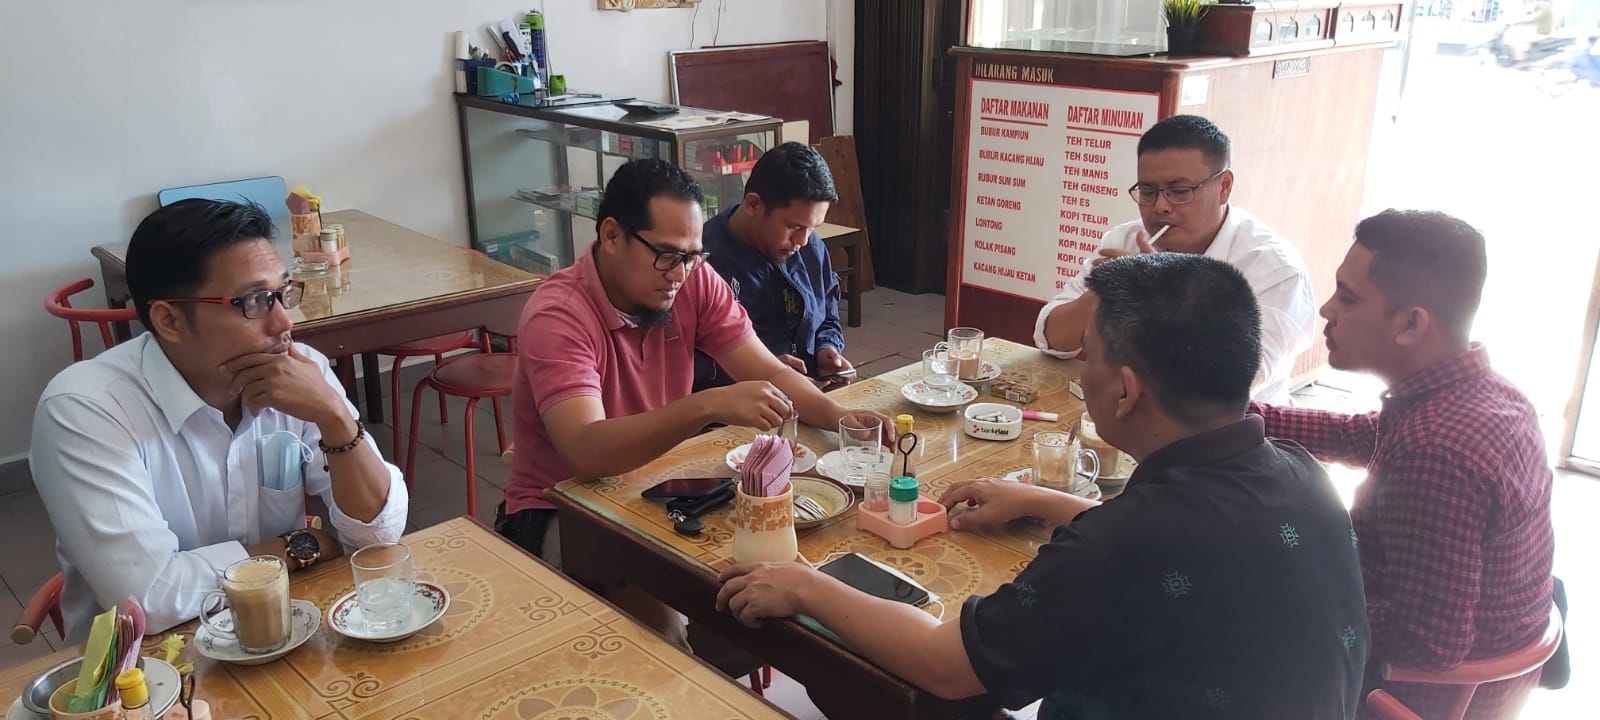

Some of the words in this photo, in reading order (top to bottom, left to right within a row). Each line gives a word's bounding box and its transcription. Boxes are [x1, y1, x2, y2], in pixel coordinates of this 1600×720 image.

[975, 63, 1017, 80] DILARANG
[1021, 66, 1054, 83] MASUK
[981, 97, 1009, 116] DAFTAR
[1010, 100, 1049, 120] MAKANAN
[1067, 105, 1099, 125] DAFTAR
[1101, 109, 1143, 129] MINUMAN
[980, 126, 1001, 137] BUBUR
[1001, 128, 1029, 140] KAMPIUN
[1065, 136, 1082, 146] TEH
[1084, 138, 1112, 149] TELUR
[979, 149, 999, 161] BUBUR
[999, 152, 1025, 164] KACANG
[1025, 155, 1045, 167] HIJAU
[1065, 151, 1081, 161] TEH
[1083, 153, 1106, 164] SUSU
[978, 172, 998, 184] BUBUR
[998, 175, 1012, 186] SUM
[1012, 177, 1026, 188] SUM
[1064, 166, 1080, 176] TEH
[1081, 168, 1109, 180] MANIS
[1062, 180, 1079, 191] TEH
[1081, 183, 1119, 197] GINSENG
[976, 195, 996, 207] KETAN
[996, 198, 1021, 210] GORENG
[1061, 195, 1077, 206] TEH
[1079, 198, 1090, 207] ES
[975, 217, 1003, 231] LONTONG
[1060, 210, 1079, 220] KOPI
[1082, 213, 1109, 225] TELUR
[1059, 224, 1078, 235] KOPI
[1080, 228, 1103, 240] SUSU
[974, 239, 994, 252] KOLAK
[994, 243, 1016, 256] PISANG
[1058, 238, 1077, 249] KOPI
[1057, 252, 1076, 263] KOPI
[973, 262, 997, 274] KACANG
[997, 265, 1015, 278] HIJAU
[1016, 270, 1036, 283] KETAN
